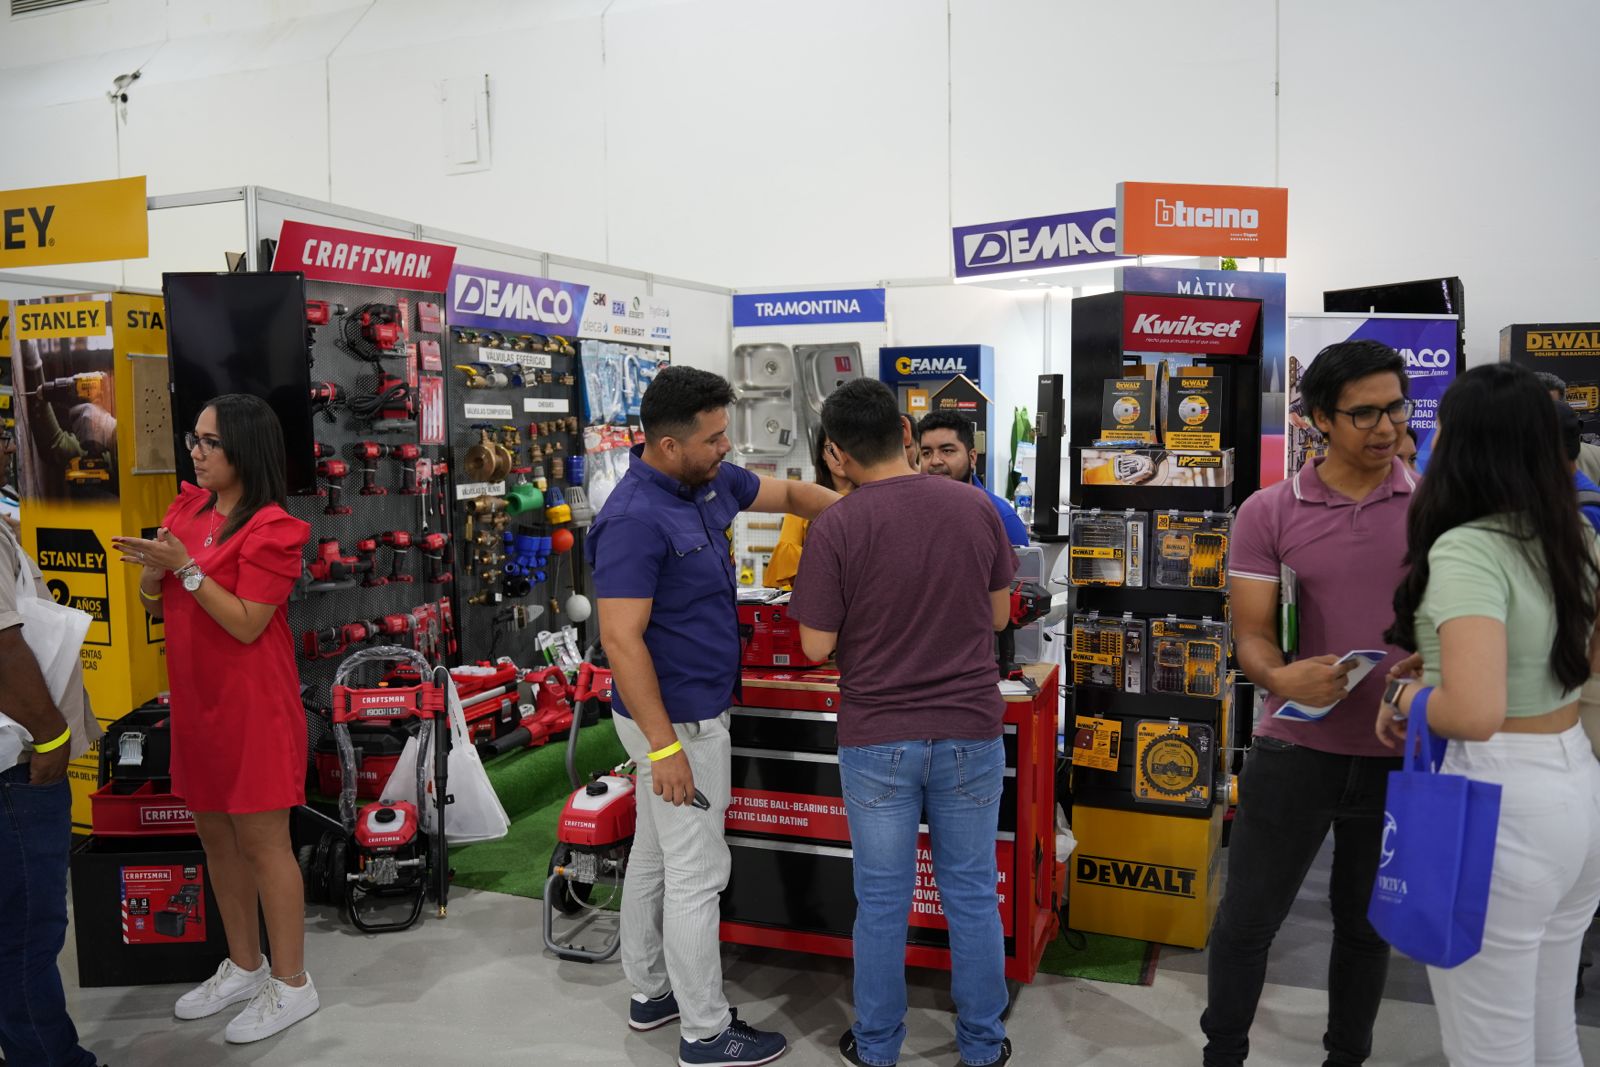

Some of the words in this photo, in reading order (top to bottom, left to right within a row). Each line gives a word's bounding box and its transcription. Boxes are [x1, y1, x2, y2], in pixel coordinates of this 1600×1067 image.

[1154, 198, 1259, 229] bticino
[0, 205, 55, 250] EY
[301, 238, 432, 279] CRAFTSMAN
[455, 273, 573, 324] DEMACO
[754, 298, 861, 318] TRAMONTINA
[21, 308, 100, 332] STANLEY
[1131, 313, 1242, 338] Kwikset
[39, 550, 105, 569] STANLEY
[76, 597, 102, 611] AÑOS
[362, 696, 406, 704] CRAFTSMAN
[330, 769, 377, 780] CRSMAN
[744, 798, 769, 809] CLOSE
[770, 799, 829, 814] BALL-BEARING
[564, 820, 596, 829] CRAFTSMAN
[728, 811, 756, 821] STATIC
[757, 815, 778, 824] LOAD
[779, 817, 809, 827] RATING
[125, 871, 170, 881] CRAFTSMAN
[913, 889, 941, 902] OWE
[912, 901, 944, 915] TOOLS
